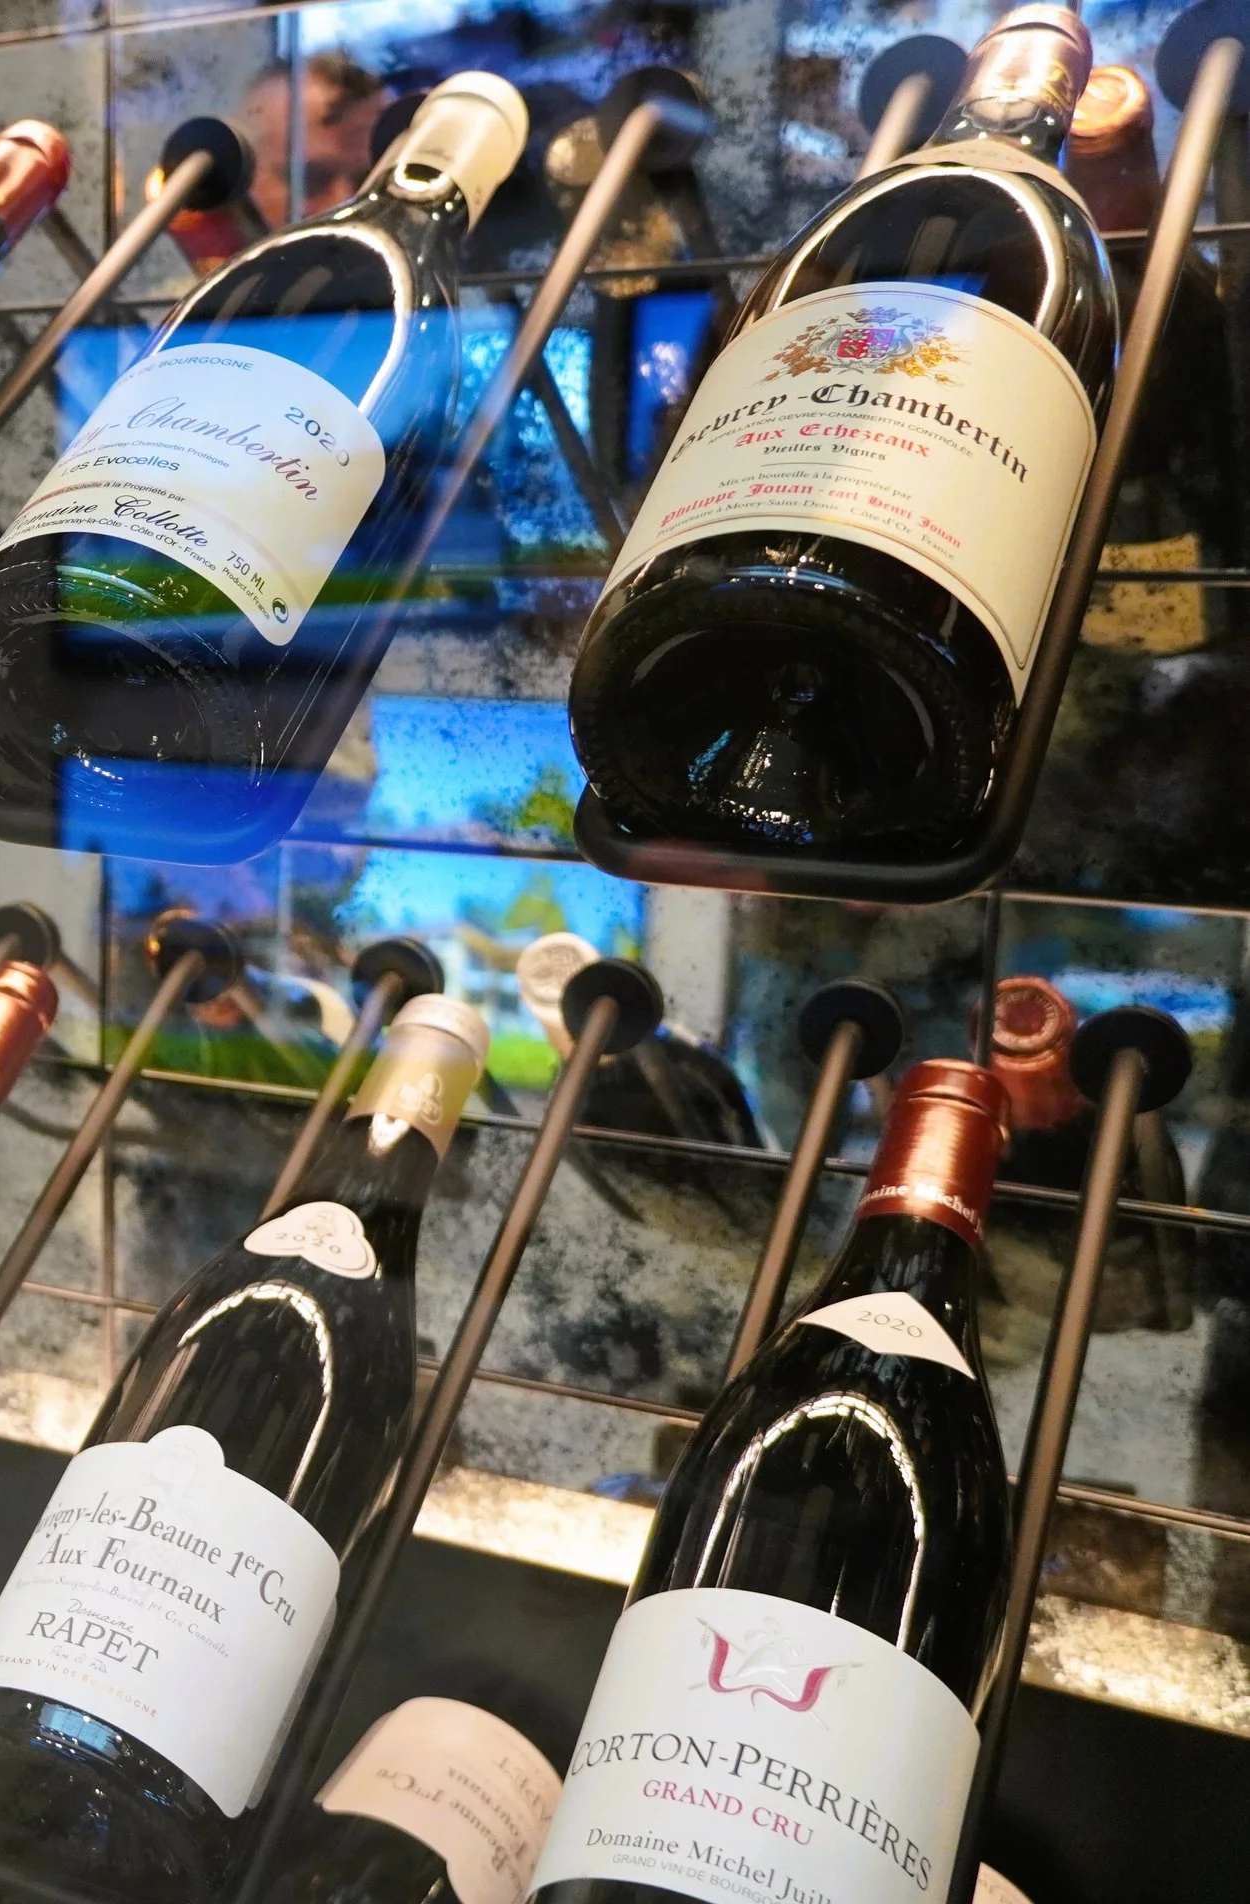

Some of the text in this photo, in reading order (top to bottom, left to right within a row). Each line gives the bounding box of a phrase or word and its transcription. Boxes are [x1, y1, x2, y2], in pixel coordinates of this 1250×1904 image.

[158, 356, 254, 371] BOURGOGNE
[284, 405, 350, 467] 2020
[707, 416, 776, 445] APPELLATION
[777, 411, 906, 428] GEVREY-CHAMBERTIN
[733, 422, 931, 458] Aux Echezeaux
[60, 459, 91, 477] Les
[93, 455, 181, 472] Evocelles
[763, 443, 887, 462] Vieilles Vignes
[111, 479, 122, 488] la
[123, 482, 167, 498] Propriété
[167, 491, 186, 503] par
[718, 479, 740, 490] Mis
[740, 475, 756, 484] en
[757, 470, 811, 481] bouteille
[820, 470, 832, 481] la
[892, 486, 913, 501] par
[113, 494, 209, 547] Collotte
[660, 489, 737, 528] Philippe
[743, 483, 814, 498] Jouan
[866, 493, 914, 521] Henri
[916, 514, 961, 549] Jouan
[849, 506, 880, 522] Côte
[919, 533, 956, 562] France
[129, 523, 154, 538] Côte
[155, 531, 178, 548] d'Or
[183, 545, 217, 572] France
[222, 566, 247, 593] Product
[226, 550, 266, 595] 750 ML
[856, 1309, 924, 1339] 2020
[37, 1532, 227, 1625] Aux Fournaux
[225, 1551, 265, 1579] 1er
[258, 1568, 298, 1627] Cru
[66, 1597, 135, 1634] Domaine
[25, 1610, 159, 1674] RAPET
[37, 1658, 58, 1672] VIN
[570, 1732, 932, 1892] CORTON-PERRIÈRES
[642, 1778, 815, 1846] GRAND CRU
[586, 1826, 680, 1855] Domaine
[686, 1839, 775, 1890] Michel
[611, 1852, 658, 1869] GRAND
[660, 1860, 685, 1875] VIN
[685, 1867, 707, 1882] DE
